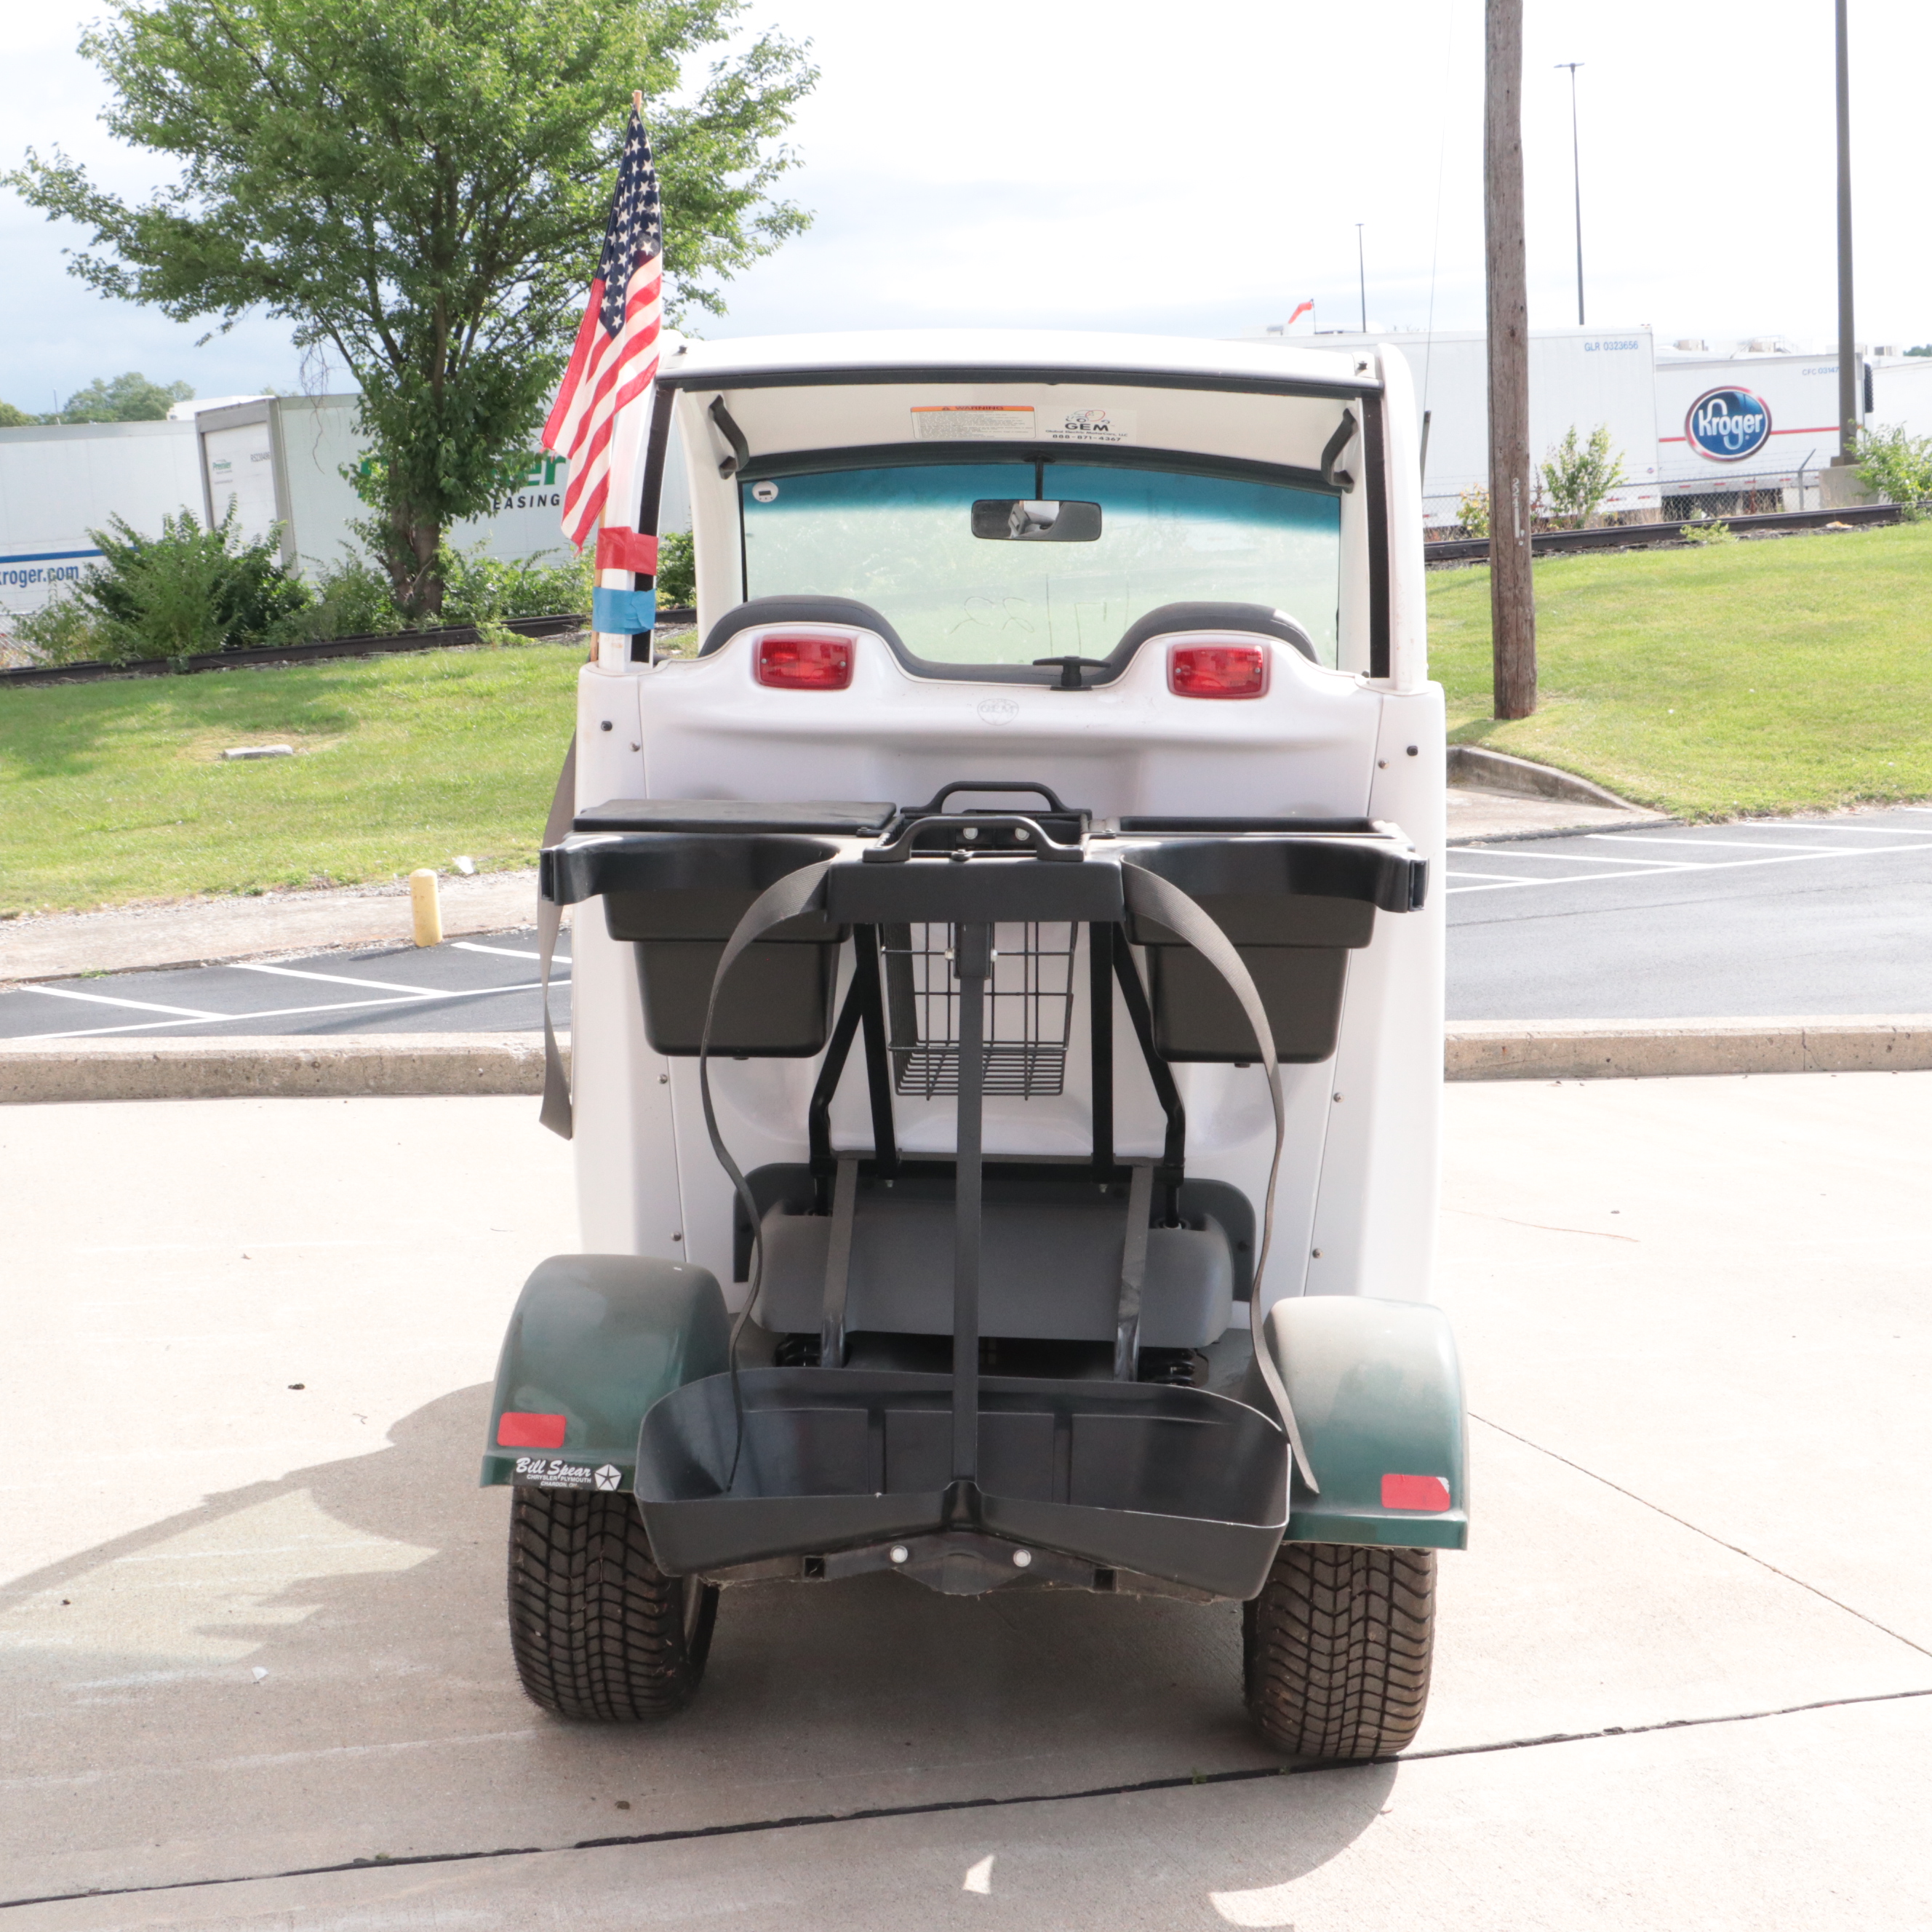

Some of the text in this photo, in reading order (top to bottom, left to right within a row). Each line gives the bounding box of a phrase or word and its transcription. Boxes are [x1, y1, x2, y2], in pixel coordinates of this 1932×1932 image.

[1584, 340, 1639, 351] GLR 0323656
[1802, 368, 1817, 376] CFC
[1065, 423, 1109, 432] GEM
[1698, 398, 1763, 450] Kroger
[492, 493, 561, 510] EASING
[516, 1457, 591, 1479] Bill Spear
[560, 1476, 591, 1484] PLYMOUTH
